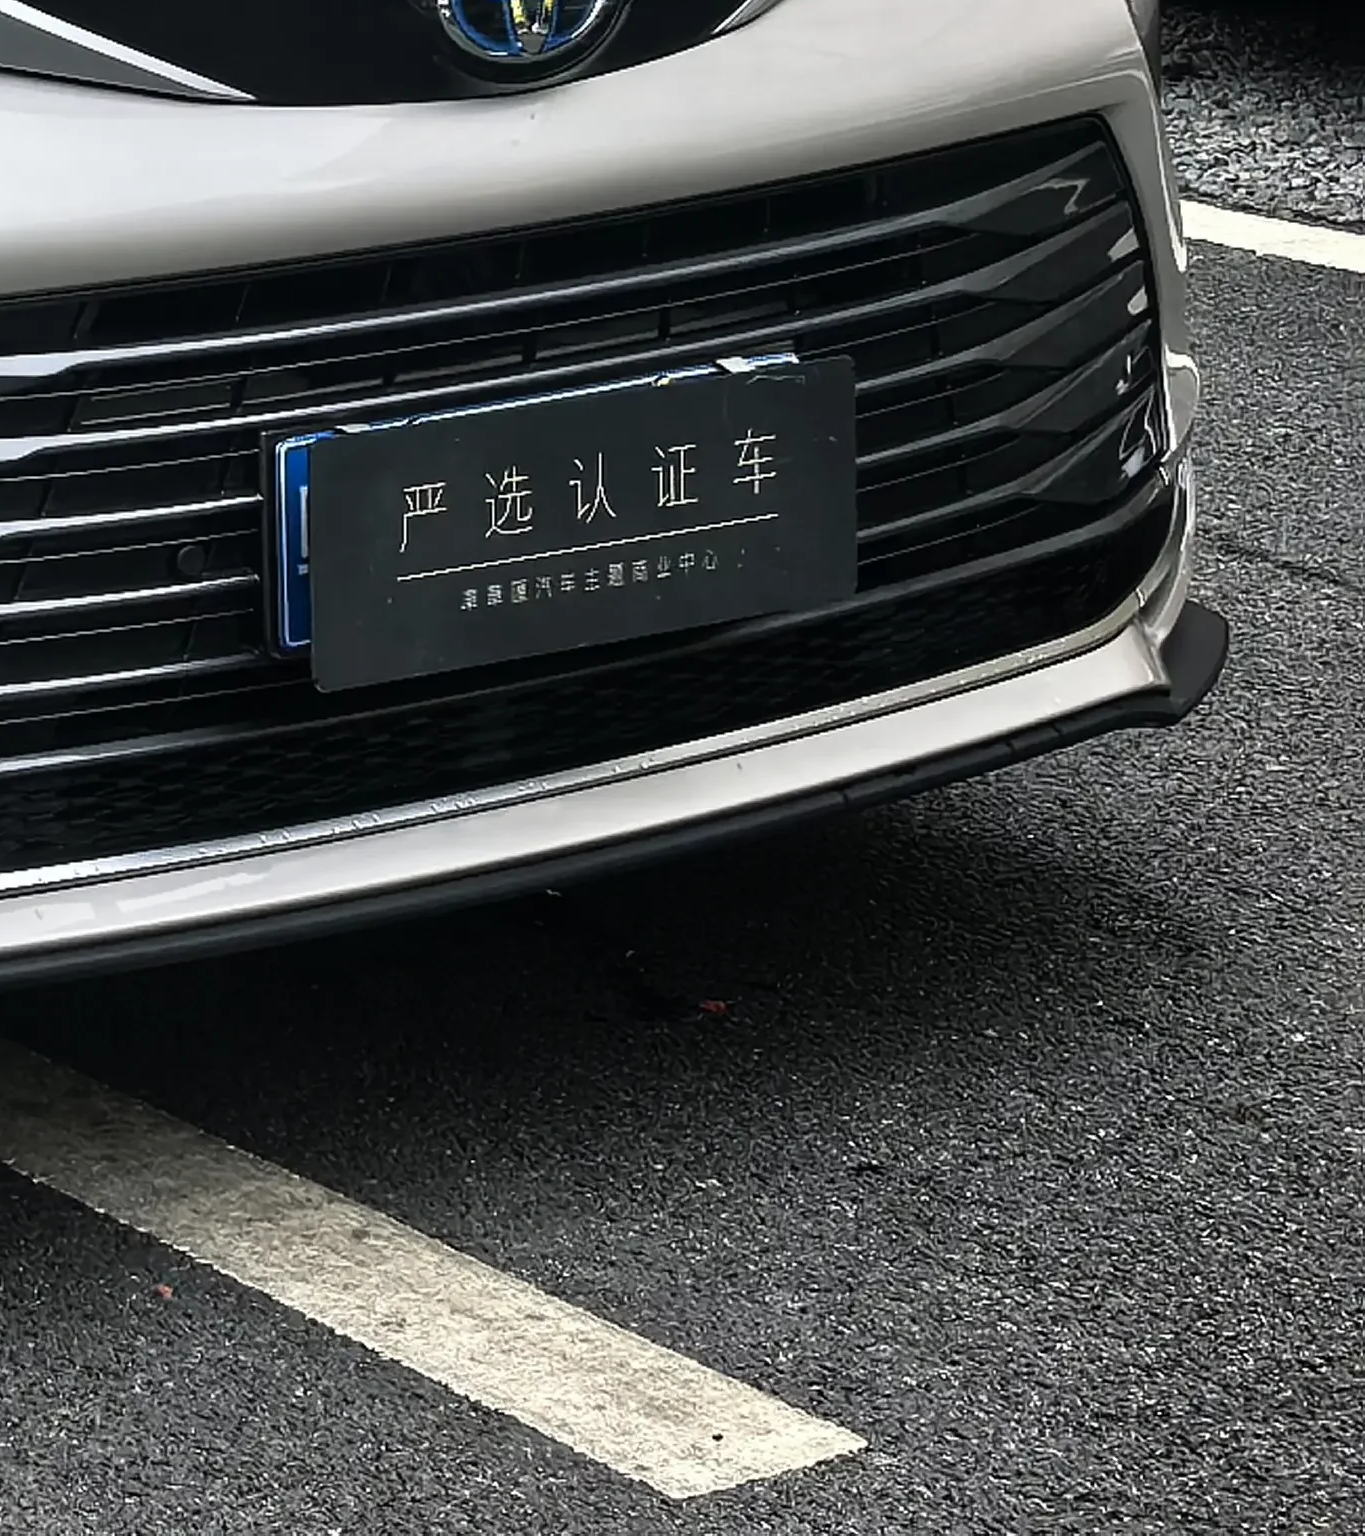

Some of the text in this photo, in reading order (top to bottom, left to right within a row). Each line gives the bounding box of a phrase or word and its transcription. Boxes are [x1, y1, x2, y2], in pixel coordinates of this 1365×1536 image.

[396, 427, 778, 554] 严选认证车
